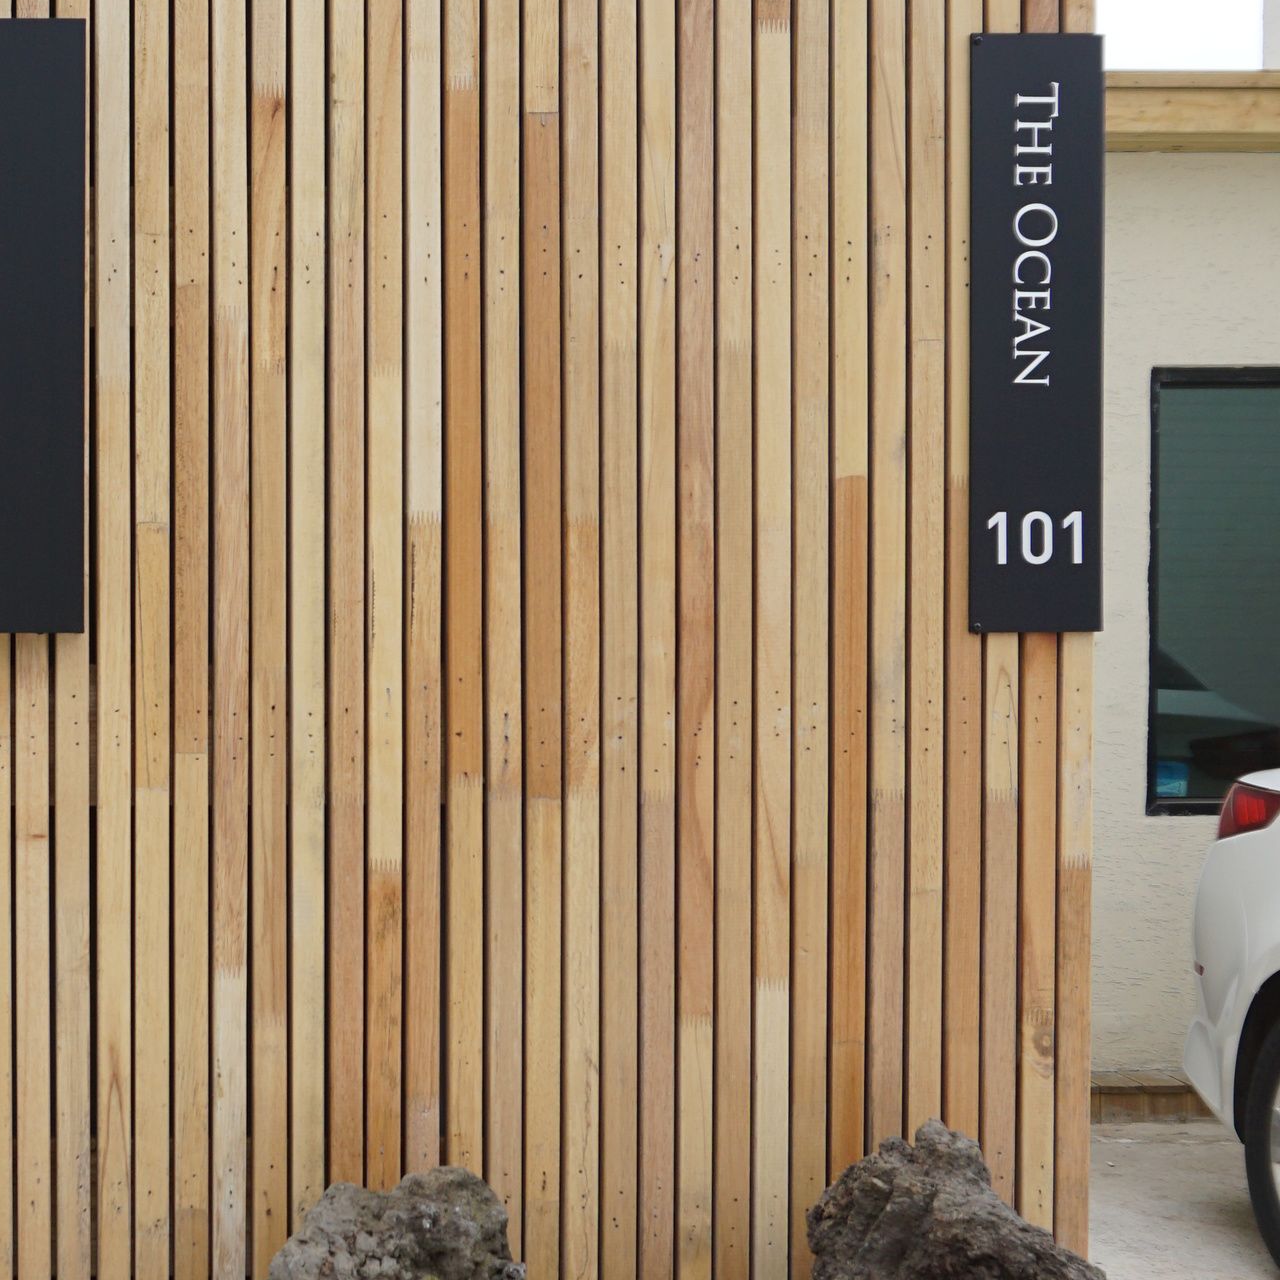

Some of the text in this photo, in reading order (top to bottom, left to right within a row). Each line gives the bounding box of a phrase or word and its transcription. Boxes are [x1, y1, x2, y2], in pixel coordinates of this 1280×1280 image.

[1012, 80, 1061, 387] THE OCEAN
[987, 510, 1084, 566] 101
